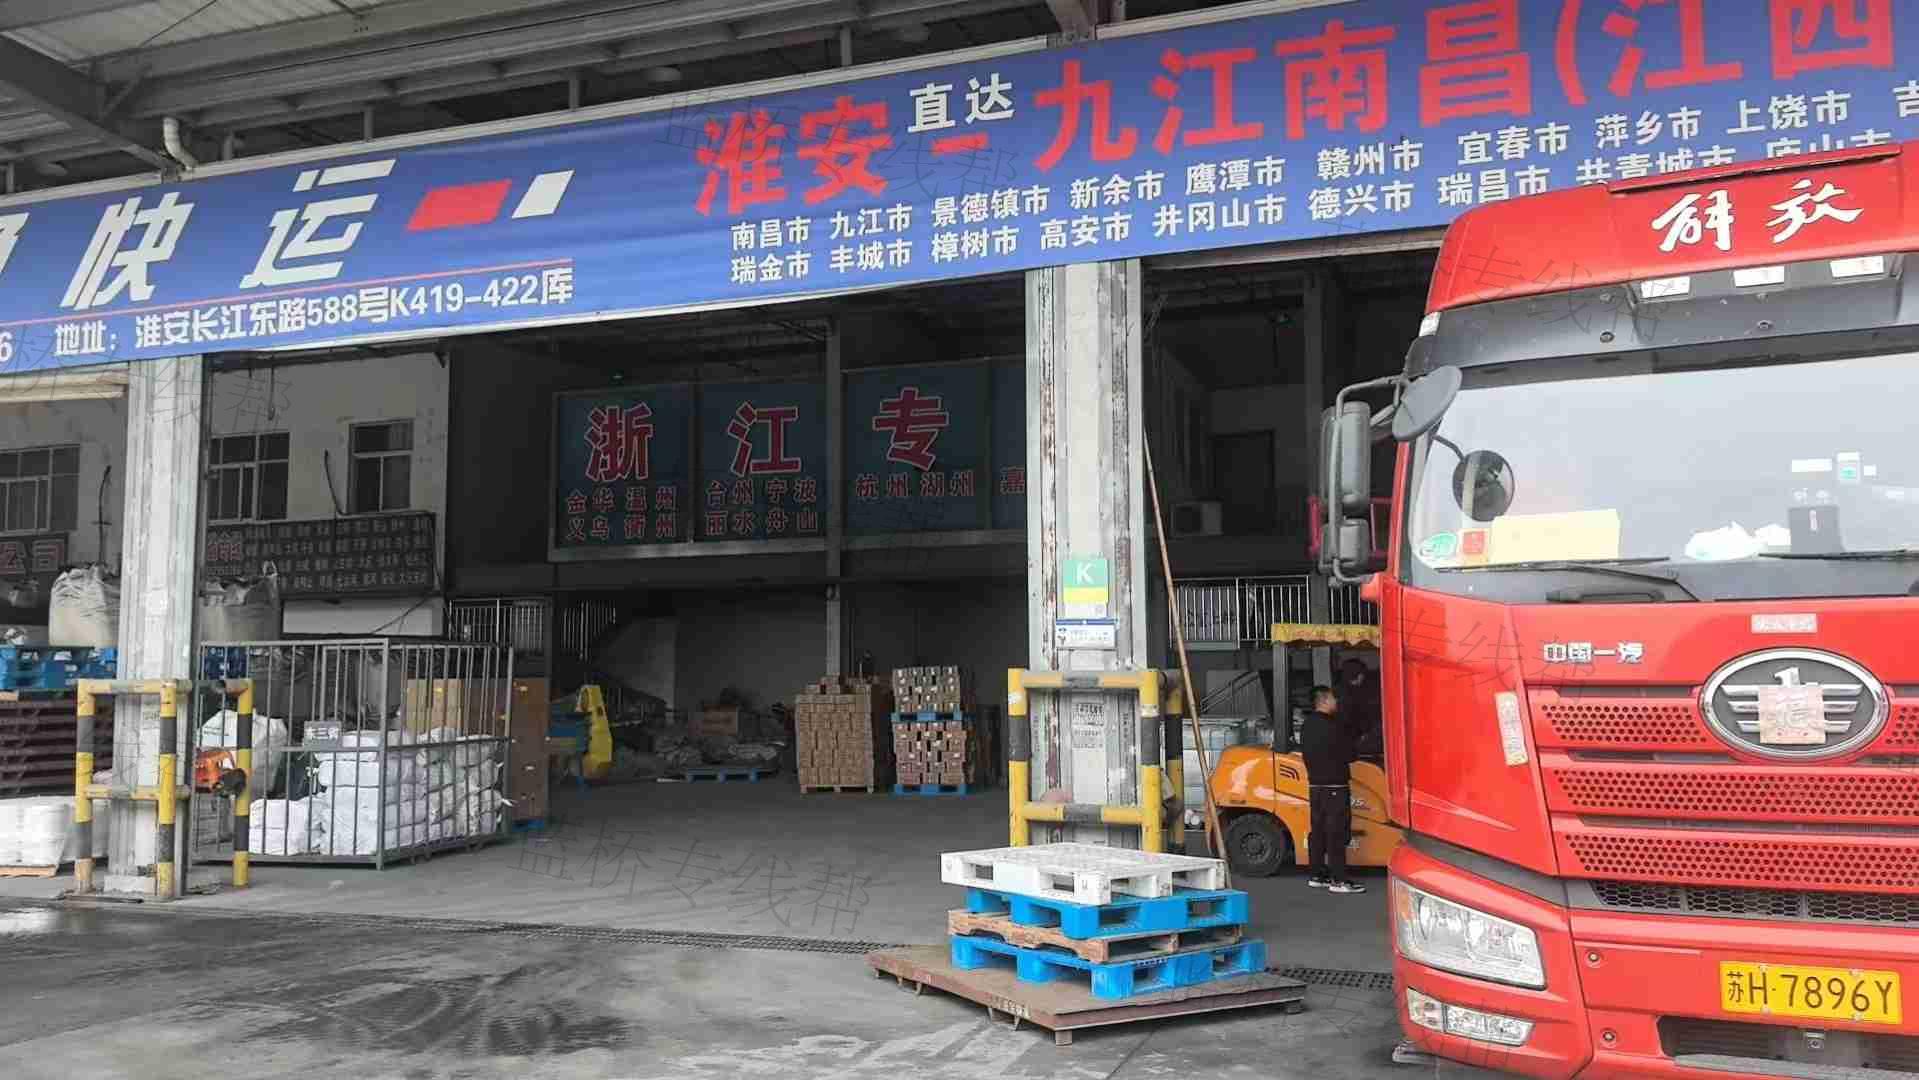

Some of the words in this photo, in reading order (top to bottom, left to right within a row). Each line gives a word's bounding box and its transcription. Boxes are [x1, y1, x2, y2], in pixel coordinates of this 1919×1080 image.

[907, 73, 1015, 133] 直达
[731, 216, 812, 252] 南昌市
[829, 203, 913, 239] 九江市
[931, 184, 1051, 230] 景德镇市
[1070, 169, 1166, 211] 新余市
[1185, 155, 1286, 196] 鹰潭市
[1317, 139, 1425, 182] 赣州市
[1457, 121, 1572, 167] 宜春市
[1595, 106, 1703, 149] 萍乡市
[1726, 89, 1852, 135] 上饶市
[731, 249, 812, 285] 瑞金市
[829, 238, 913, 274] 丰城市
[931, 225, 1019, 265] 樟树市
[1040, 212, 1131, 251] 高安市
[1154, 192, 1286, 238] 井冈山市
[1309, 180, 1414, 222] 德兴市
[1437, 165, 1551, 209] 瑞昌市
[705, 480, 754, 506] 台州
[766, 478, 818, 503] 宁波
[856, 472, 912, 498] 杭州
[919, 470, 976, 496] 湖州
[704, 511, 756, 537] 丽水
[766, 509, 819, 534] 舟山
[1076, 562, 1095, 584] K
